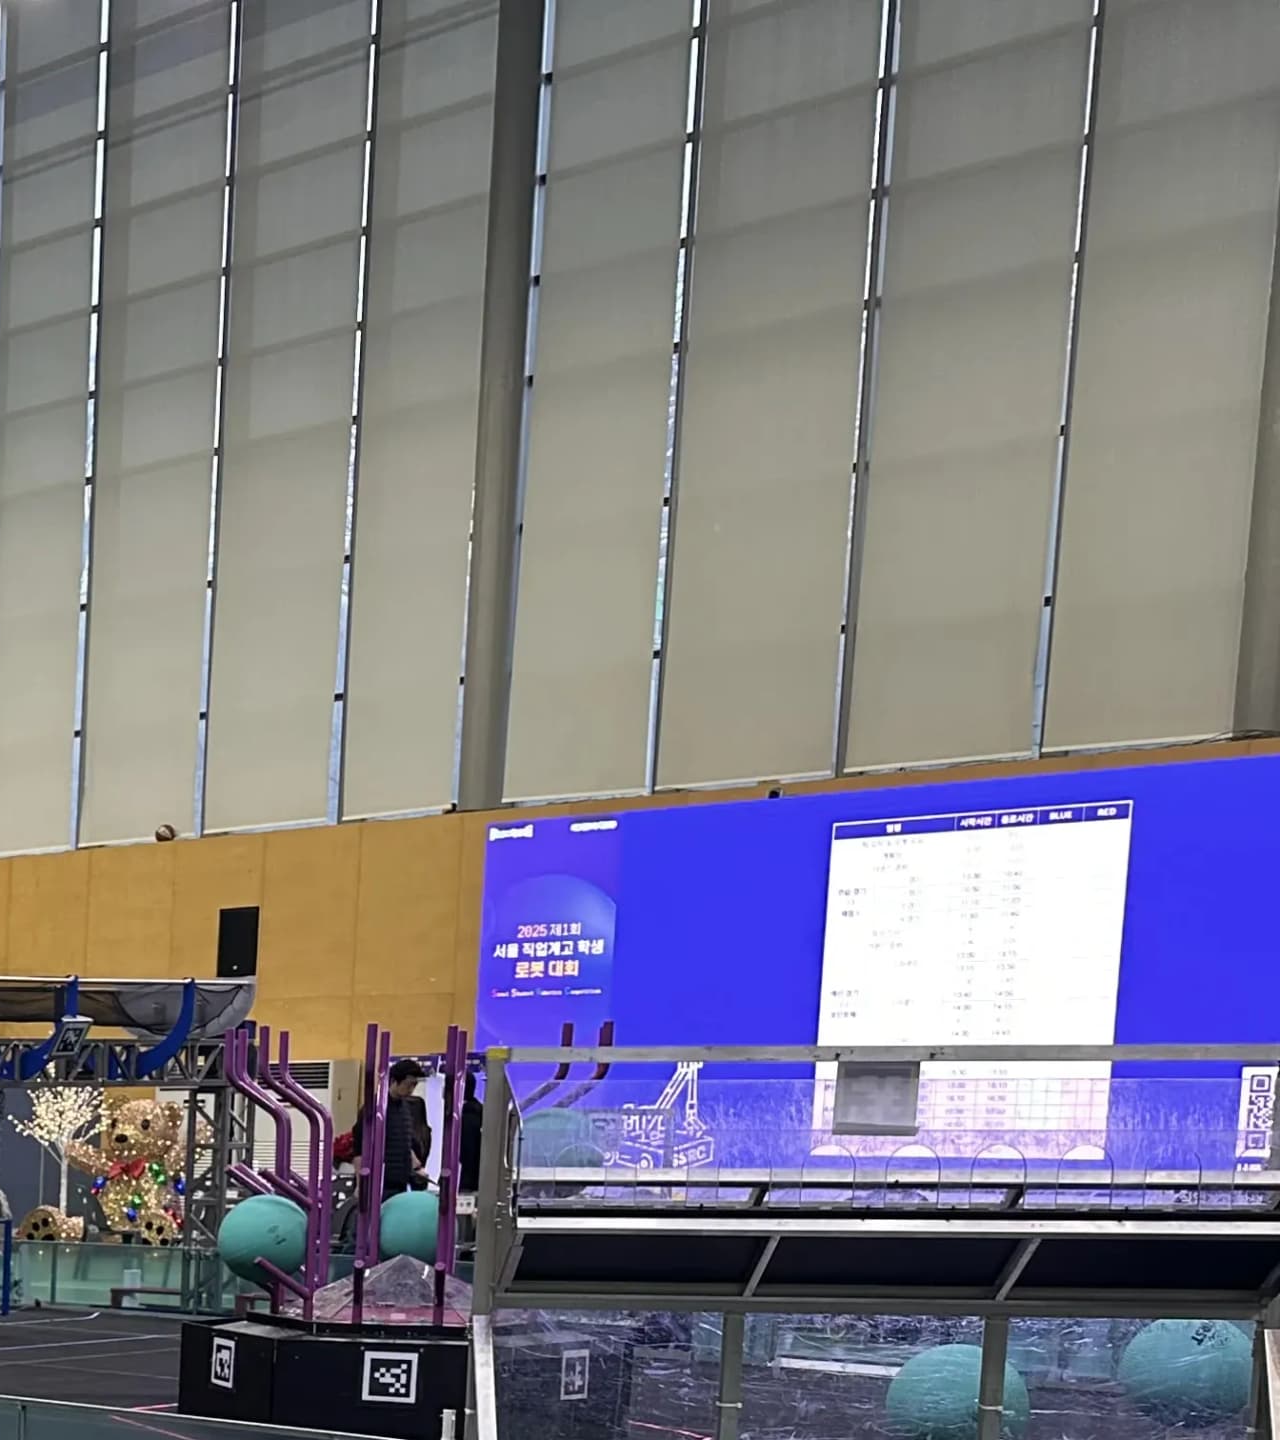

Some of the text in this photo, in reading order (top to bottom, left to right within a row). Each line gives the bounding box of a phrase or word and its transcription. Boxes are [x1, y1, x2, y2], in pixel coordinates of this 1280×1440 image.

[517, 923, 581, 938] 2025 제1회
[493, 939, 604, 959] 서울 직업계고 학생
[515, 959, 580, 979] 로봇 대회
